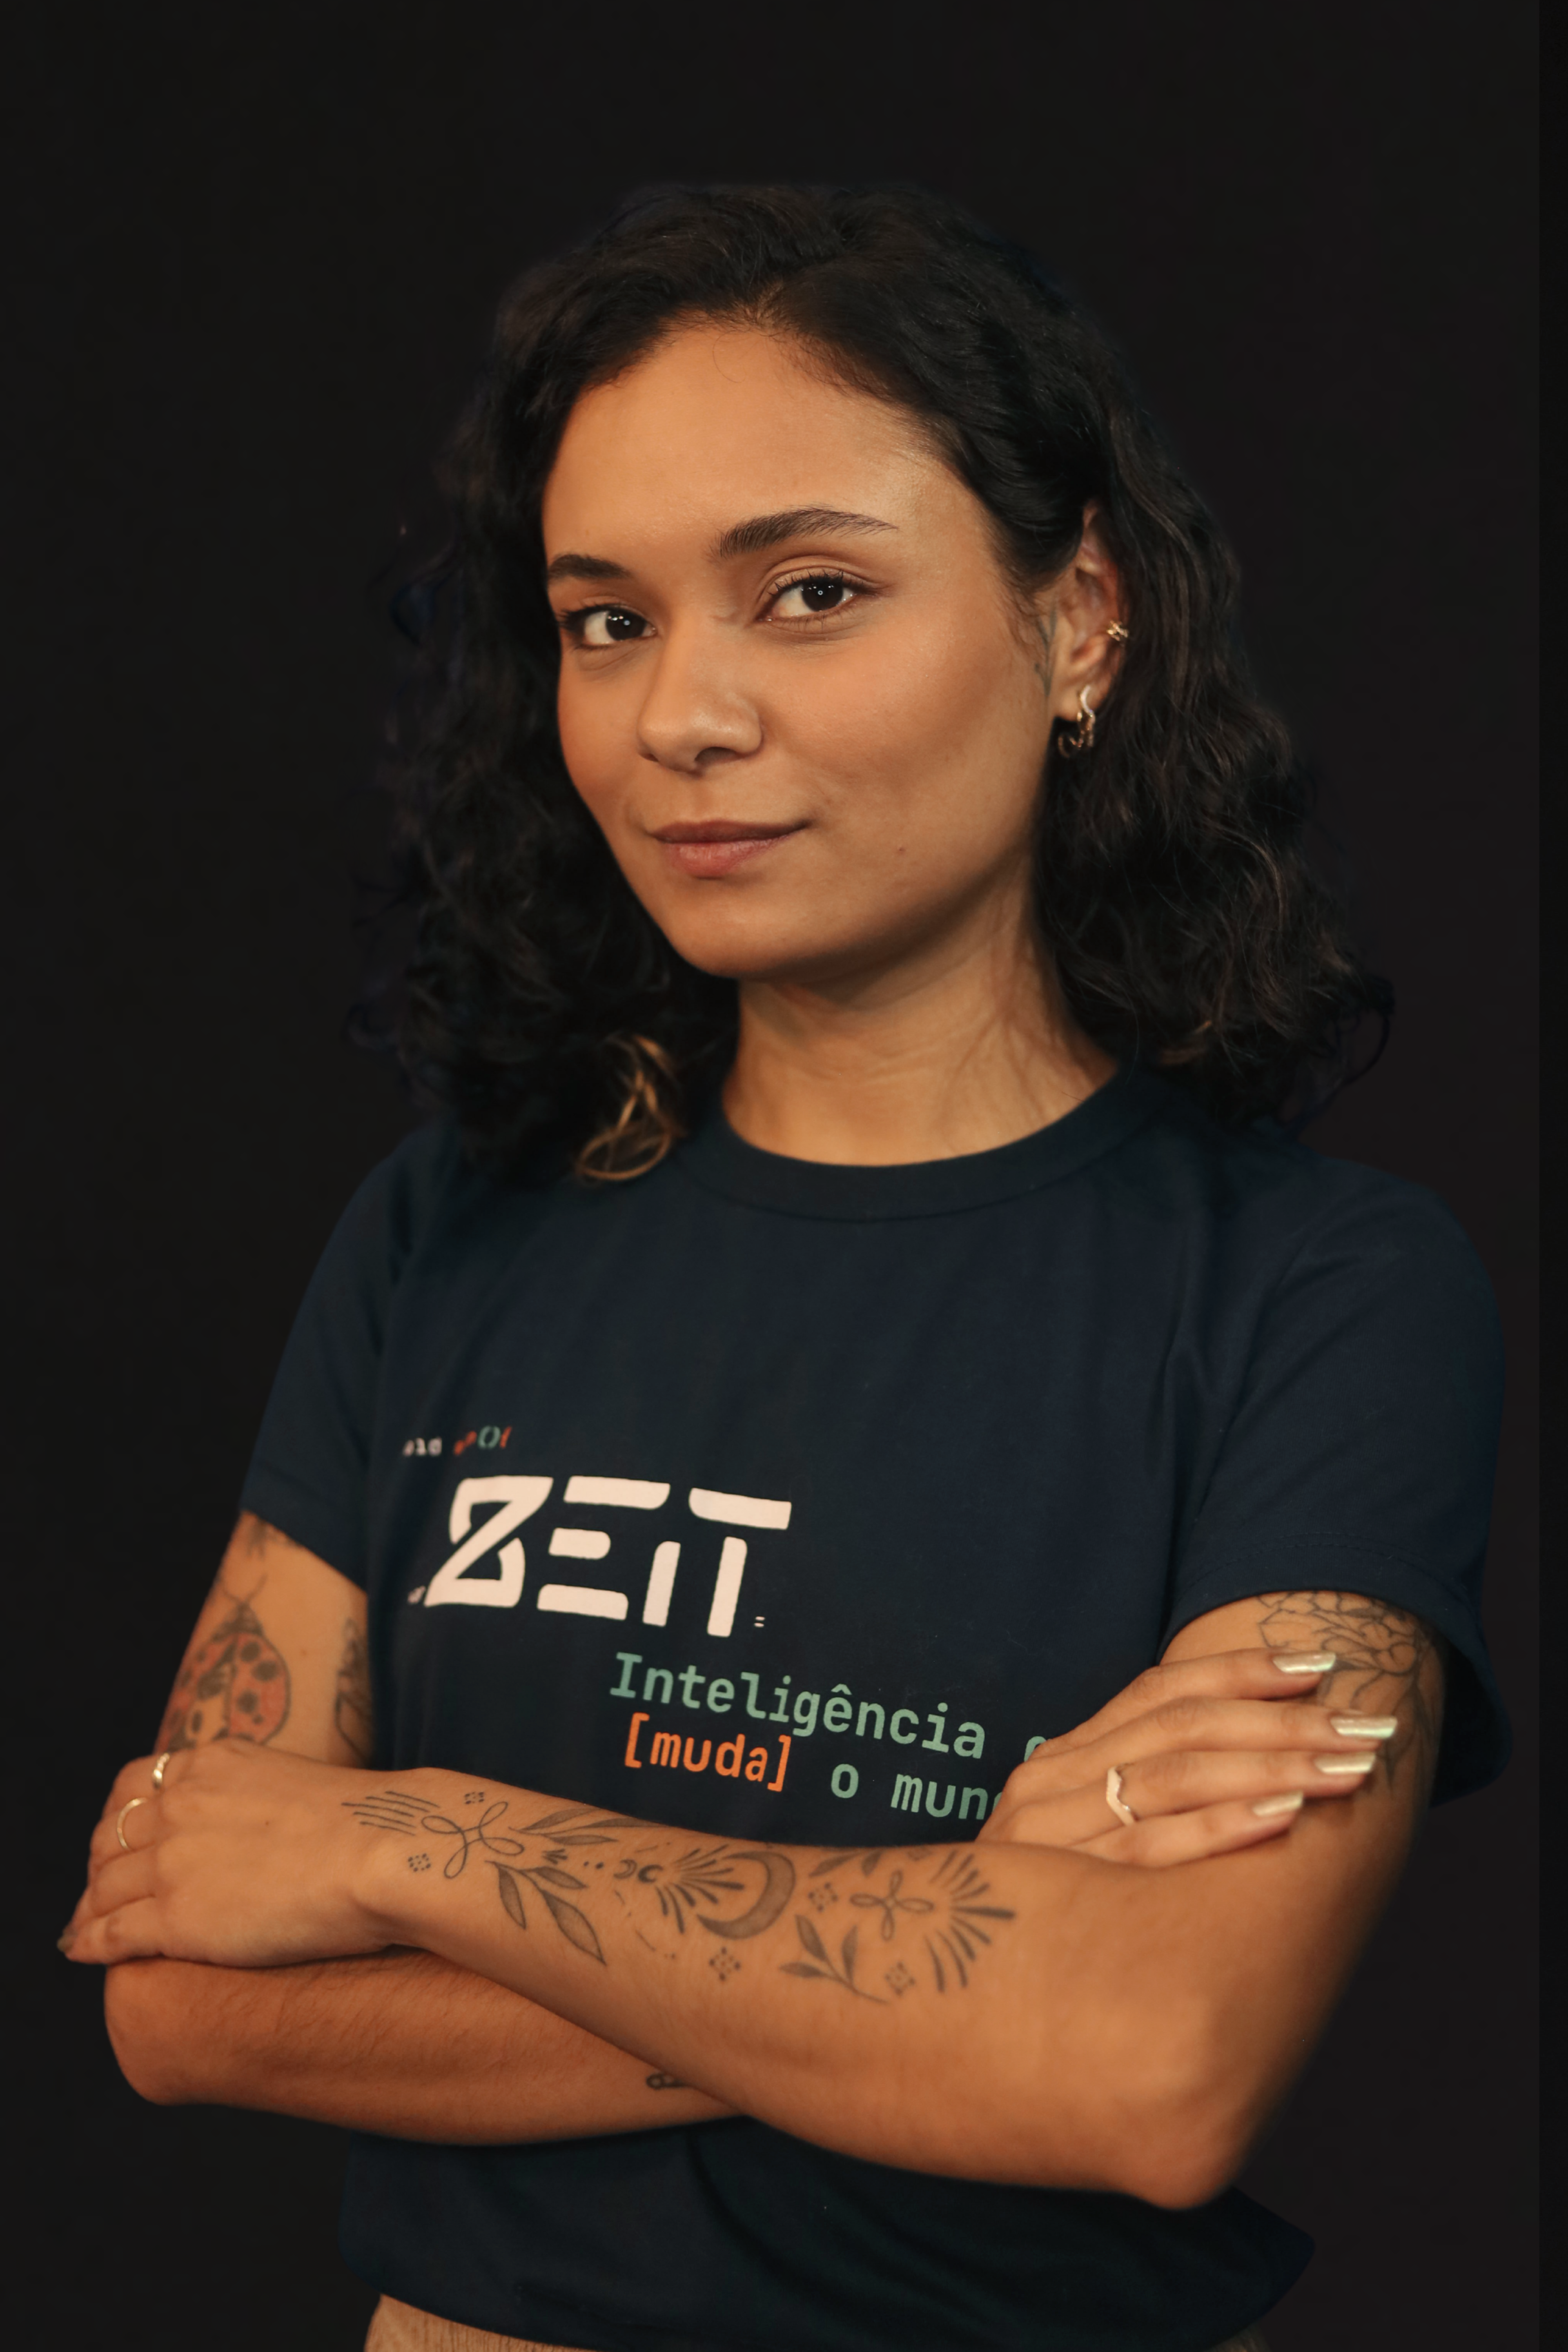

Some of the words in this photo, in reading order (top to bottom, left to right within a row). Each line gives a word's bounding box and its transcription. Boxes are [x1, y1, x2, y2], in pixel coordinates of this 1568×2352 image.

[610, 1651, 985, 1760] Inteligência
[624, 1711, 792, 1792] [muda]
[830, 1763, 859, 1799] o
[890, 1773, 1002, 1820] mun
